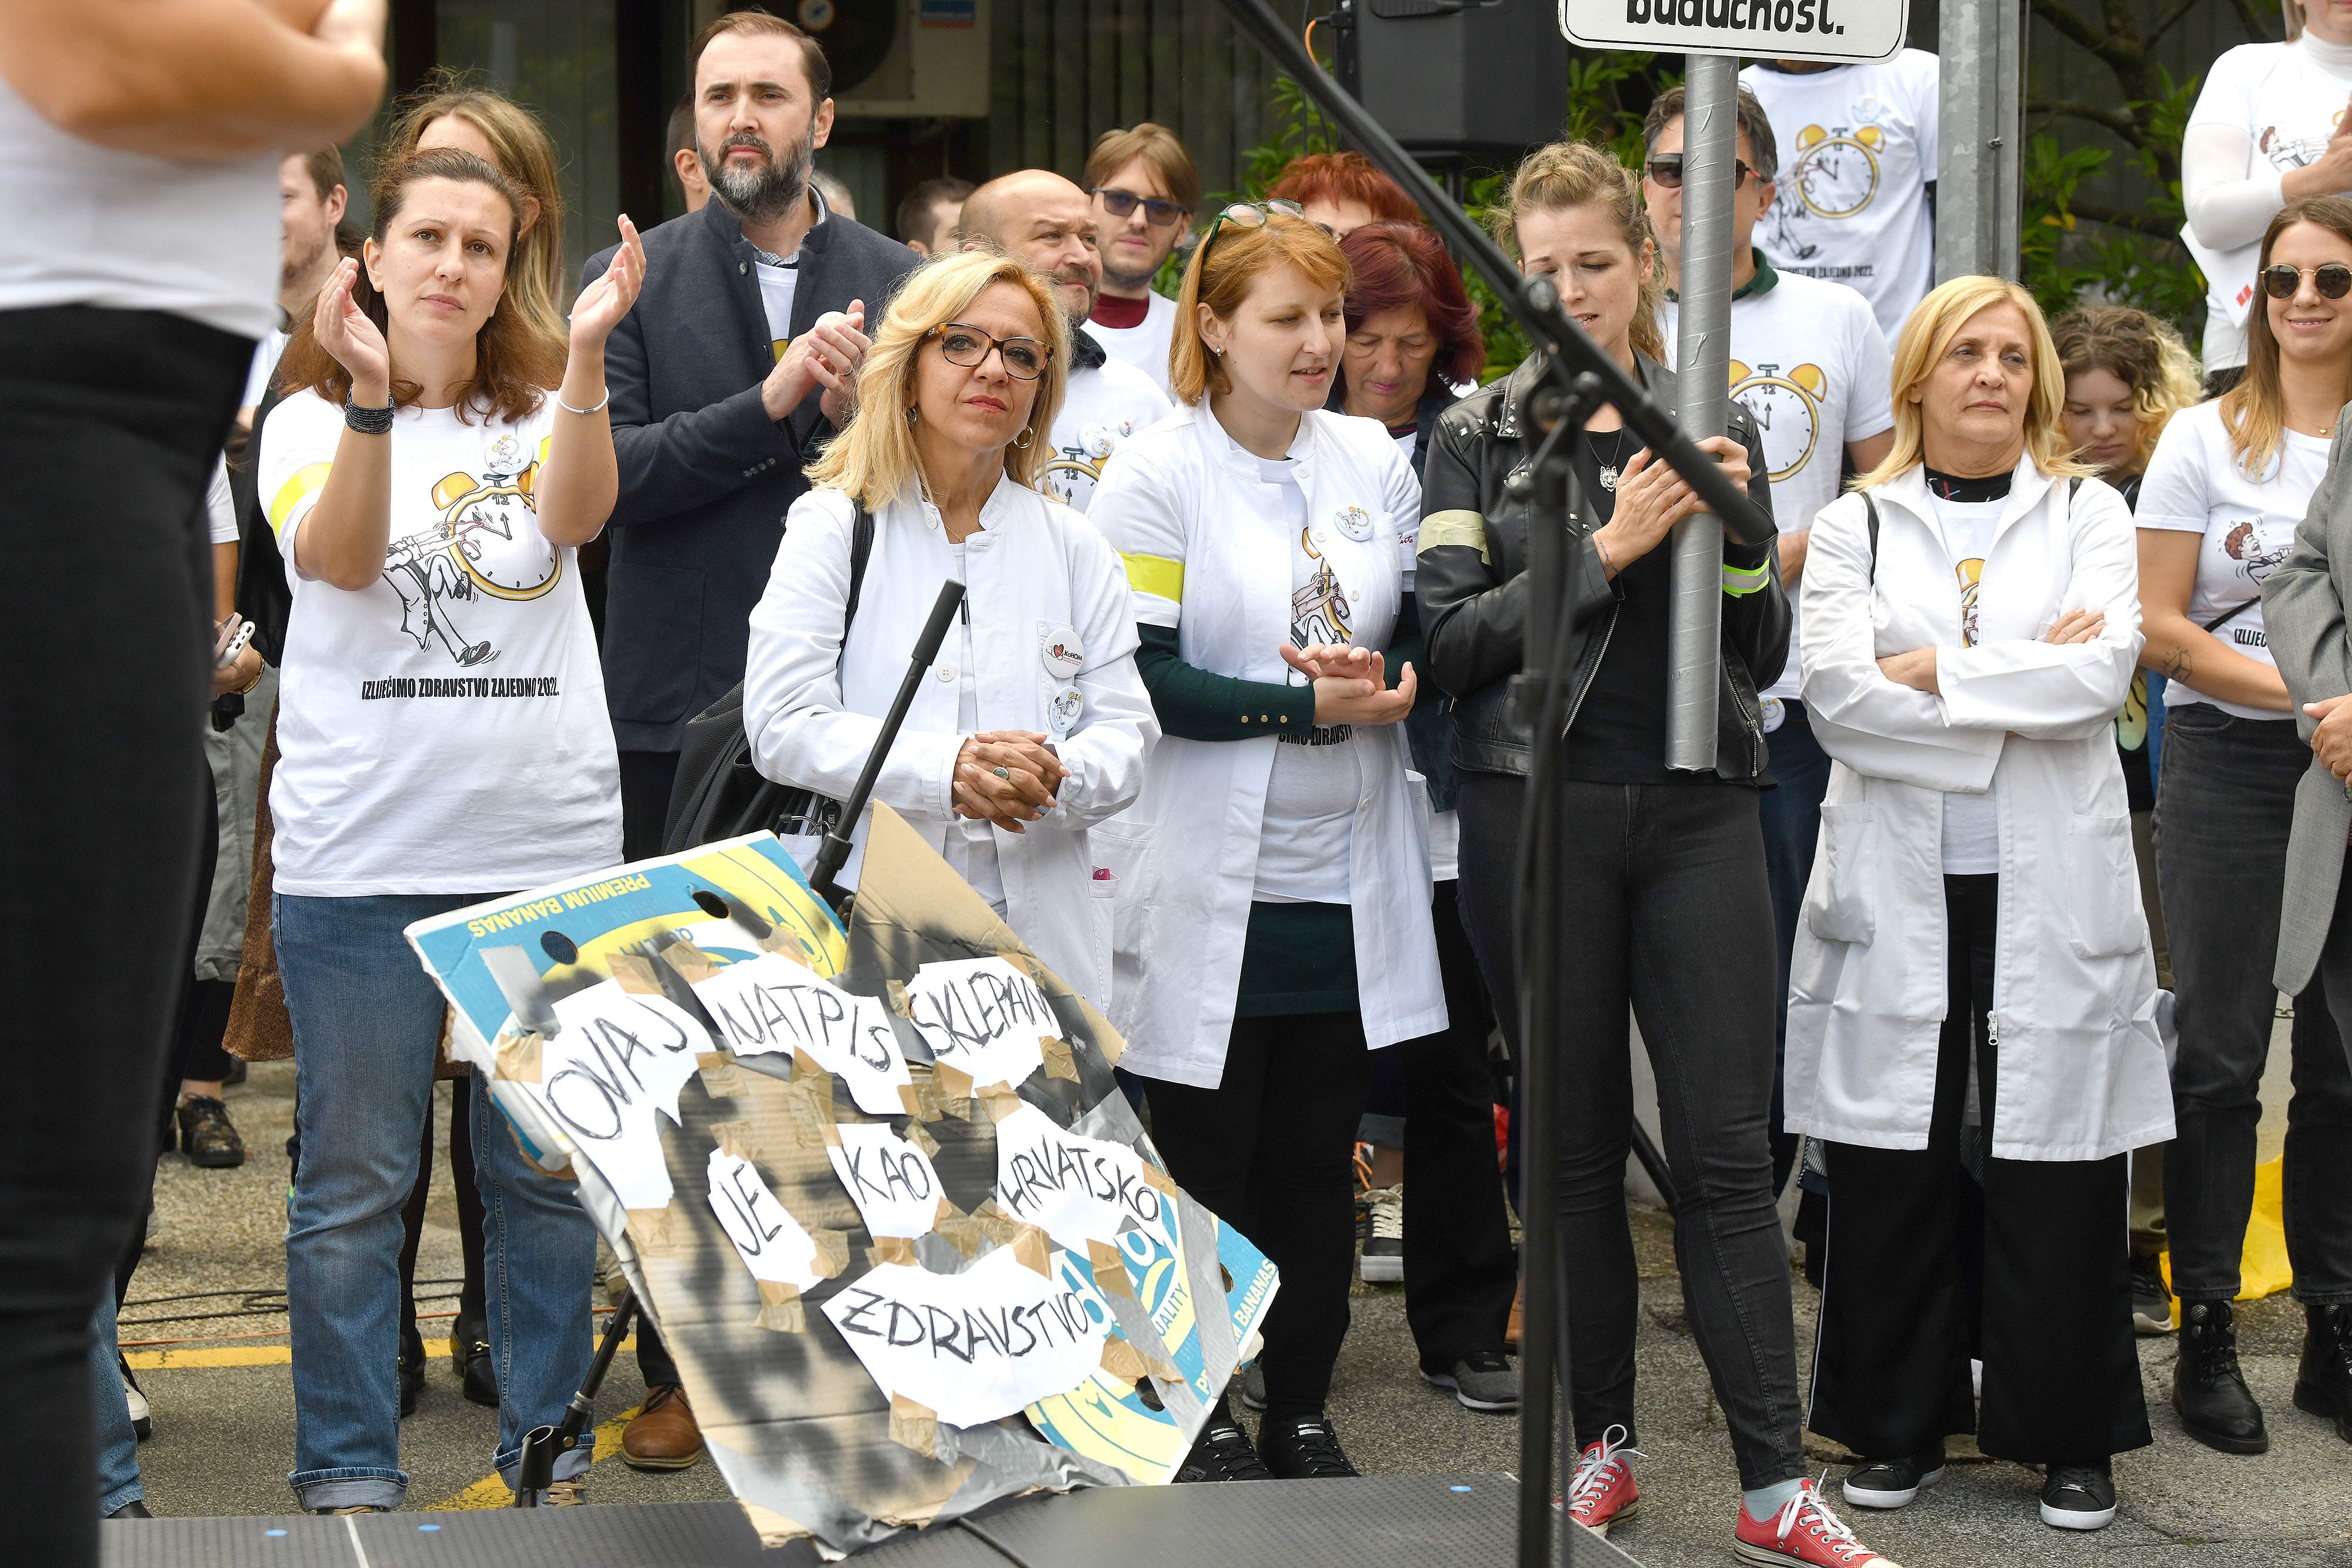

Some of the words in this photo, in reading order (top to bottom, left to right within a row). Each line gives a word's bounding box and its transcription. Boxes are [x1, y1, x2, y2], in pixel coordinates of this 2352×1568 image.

[1761, 384, 1776, 394] 12
[1064, 469, 1078, 480] 12
[492, 494, 510, 505] 12
[1064, 650, 1083, 661] KoHOM
[362, 675, 416, 700] IZLIJEČIMO
[418, 677, 489, 697] ZDRAVSTVO
[491, 677, 536, 697] ZAJEDNO
[537, 677, 560, 696] 2022.
[561, 872, 652, 910] PREMIUM
[467, 897, 564, 937] BANANAS
[546, 996, 687, 1140] OVAJ
[717, 982, 891, 1072] NATPIS
[909, 971, 1053, 1057] SKLEPAN
[718, 1164, 782, 1256] JE
[841, 1146, 930, 1208] KAO
[1000, 1134, 1158, 1222] HRVATSKO
[1155, 1282, 1189, 1336] UALITY
[1234, 1258, 1277, 1328] BANANAS
[840, 1287, 1088, 1363] ZDRAVSTVO
